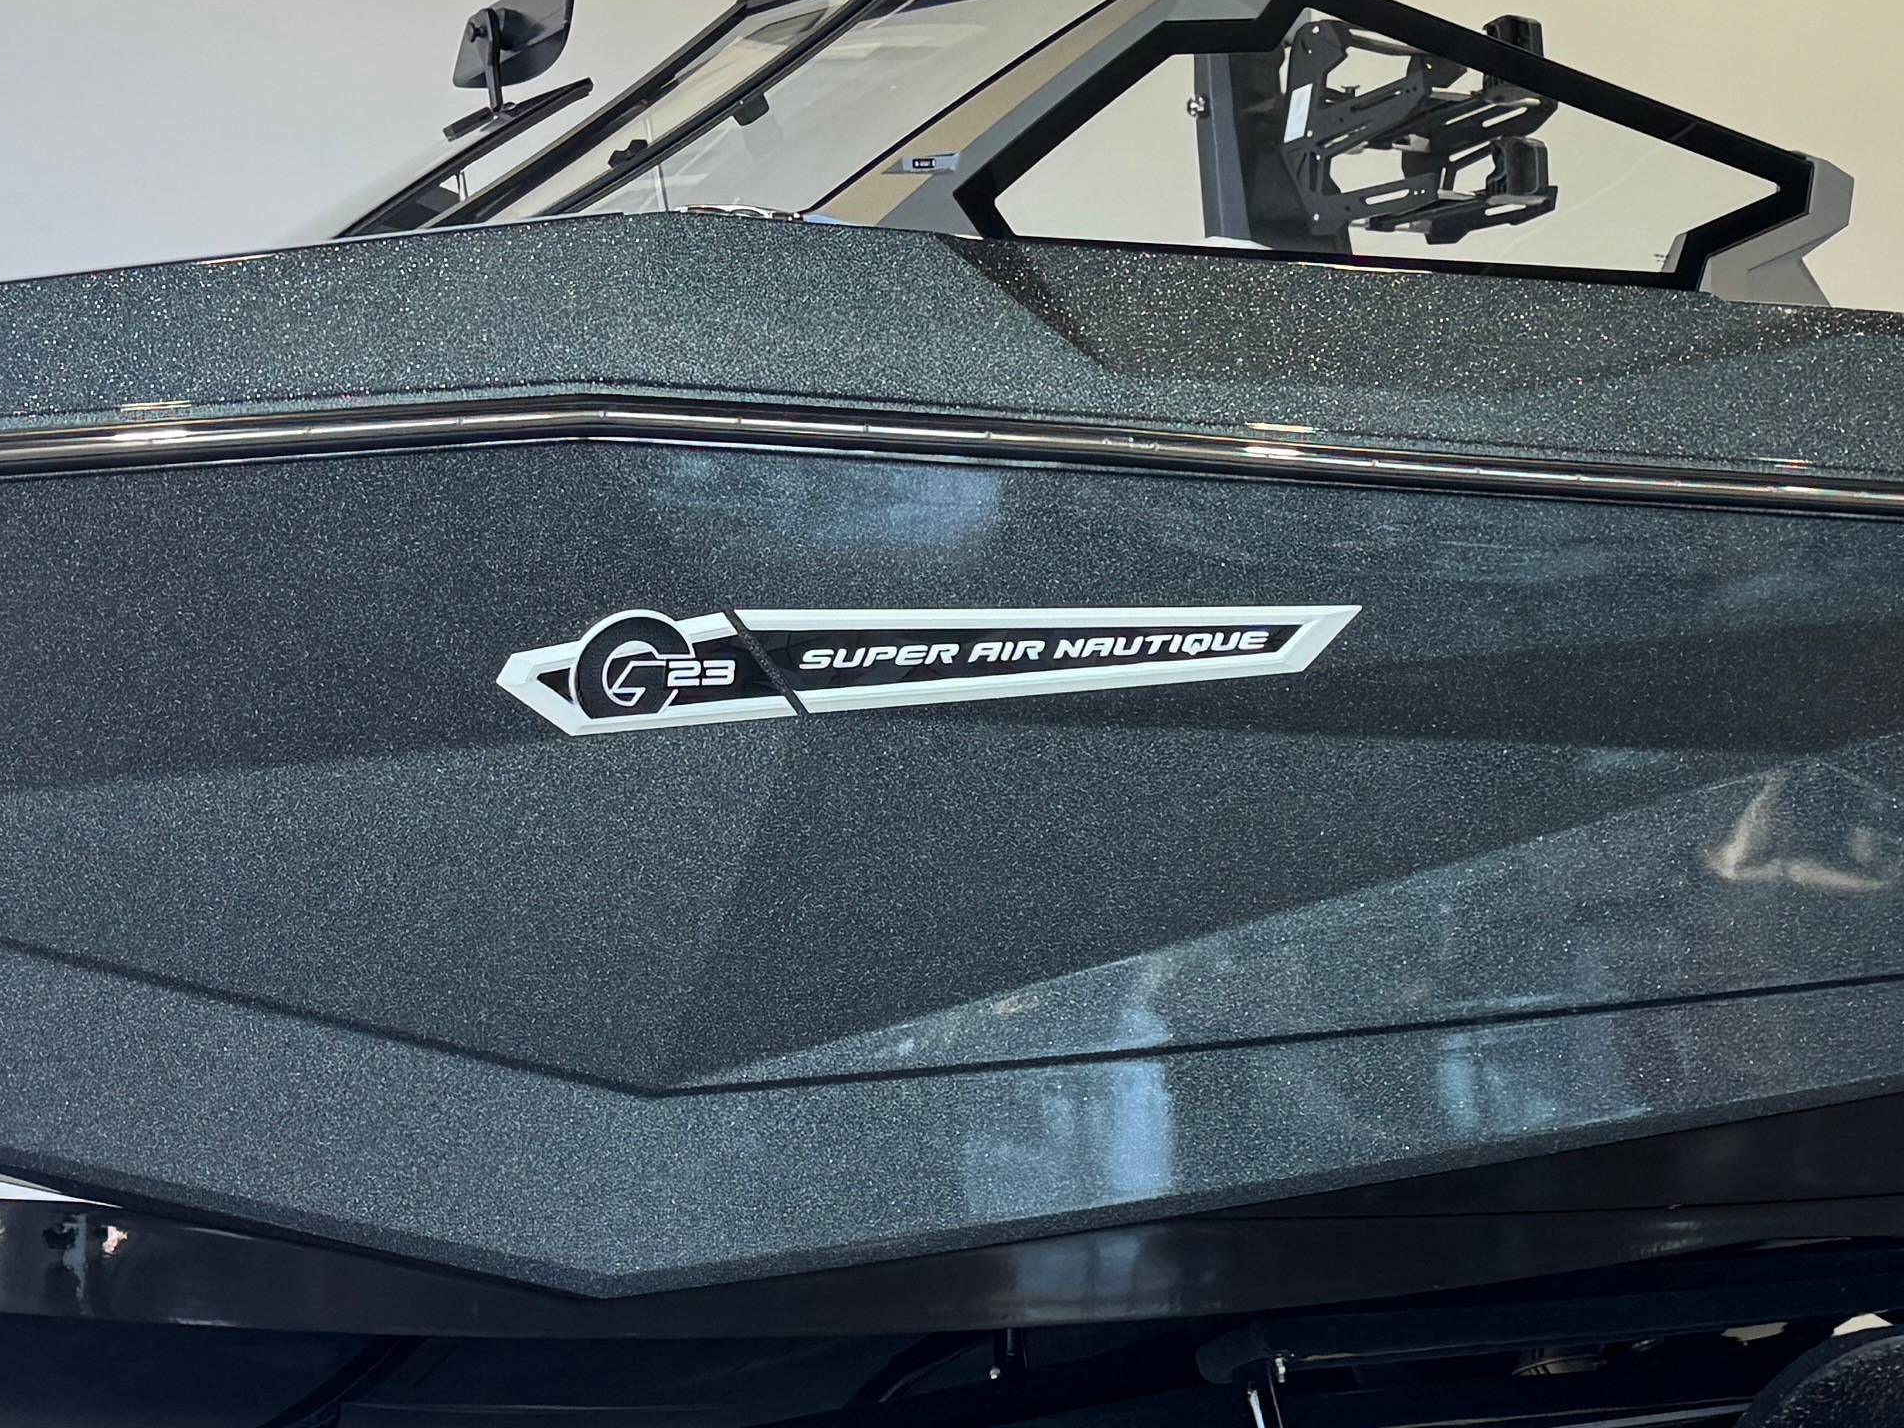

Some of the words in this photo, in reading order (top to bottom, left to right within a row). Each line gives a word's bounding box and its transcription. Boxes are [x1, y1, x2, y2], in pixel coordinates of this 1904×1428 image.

[799, 642, 959, 671] SUPER
[967, 639, 1047, 663] AIR
[1053, 630, 1271, 659] NAUTIQUE
